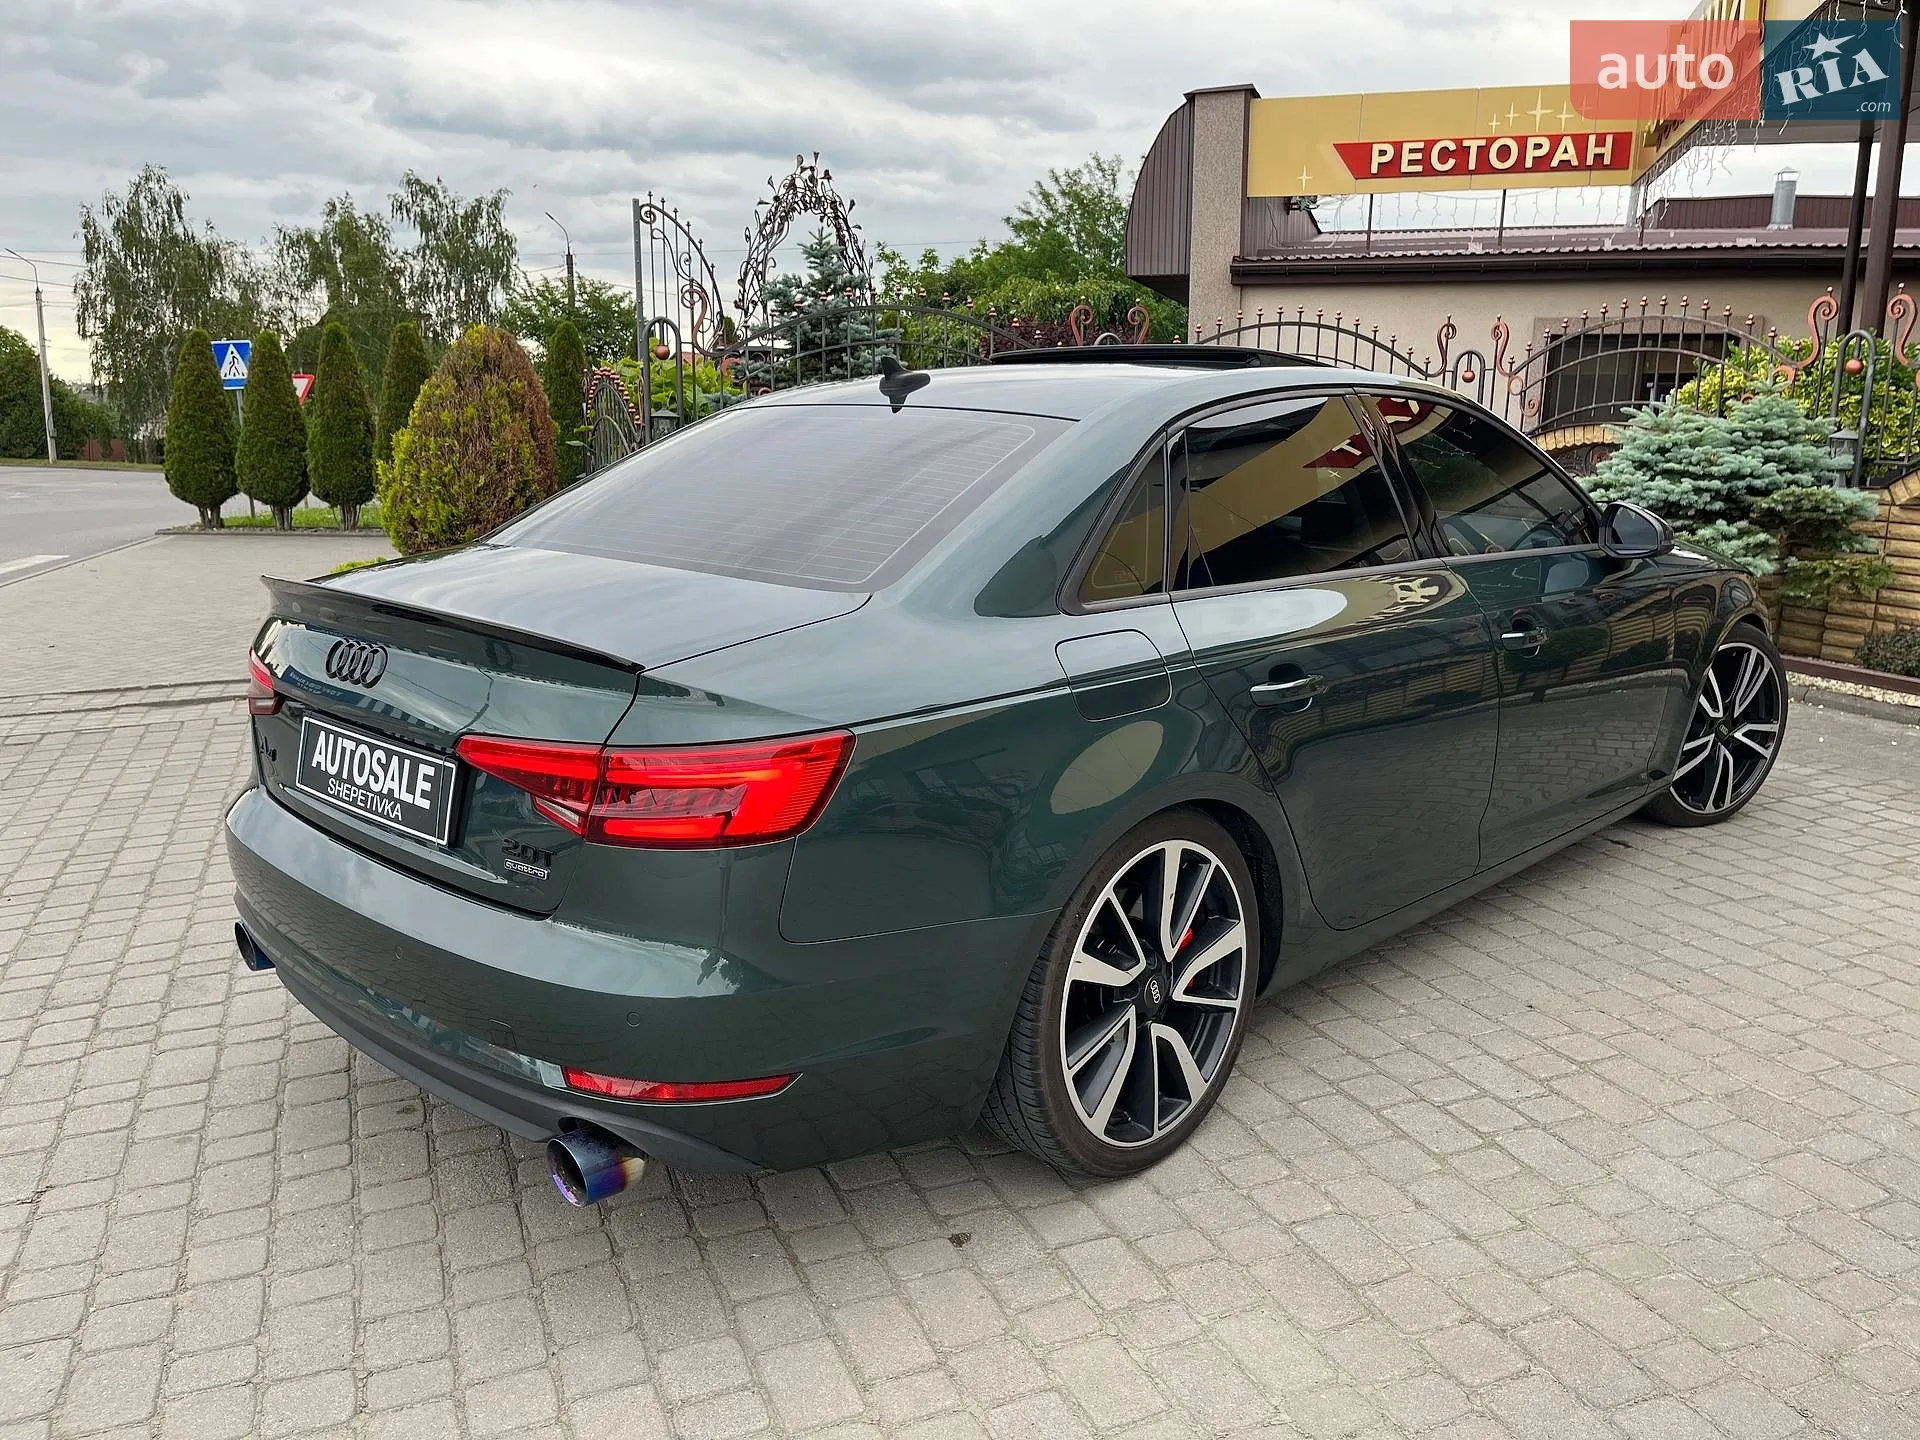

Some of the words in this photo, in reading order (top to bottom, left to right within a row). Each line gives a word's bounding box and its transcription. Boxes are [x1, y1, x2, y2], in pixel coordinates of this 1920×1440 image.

[1370, 134, 1613, 174] РЕСТОРАН
[312, 730, 435, 809] AUTOSALE
[327, 780, 402, 821] SHEPETIVKA
[505, 861, 545, 877] quattro
